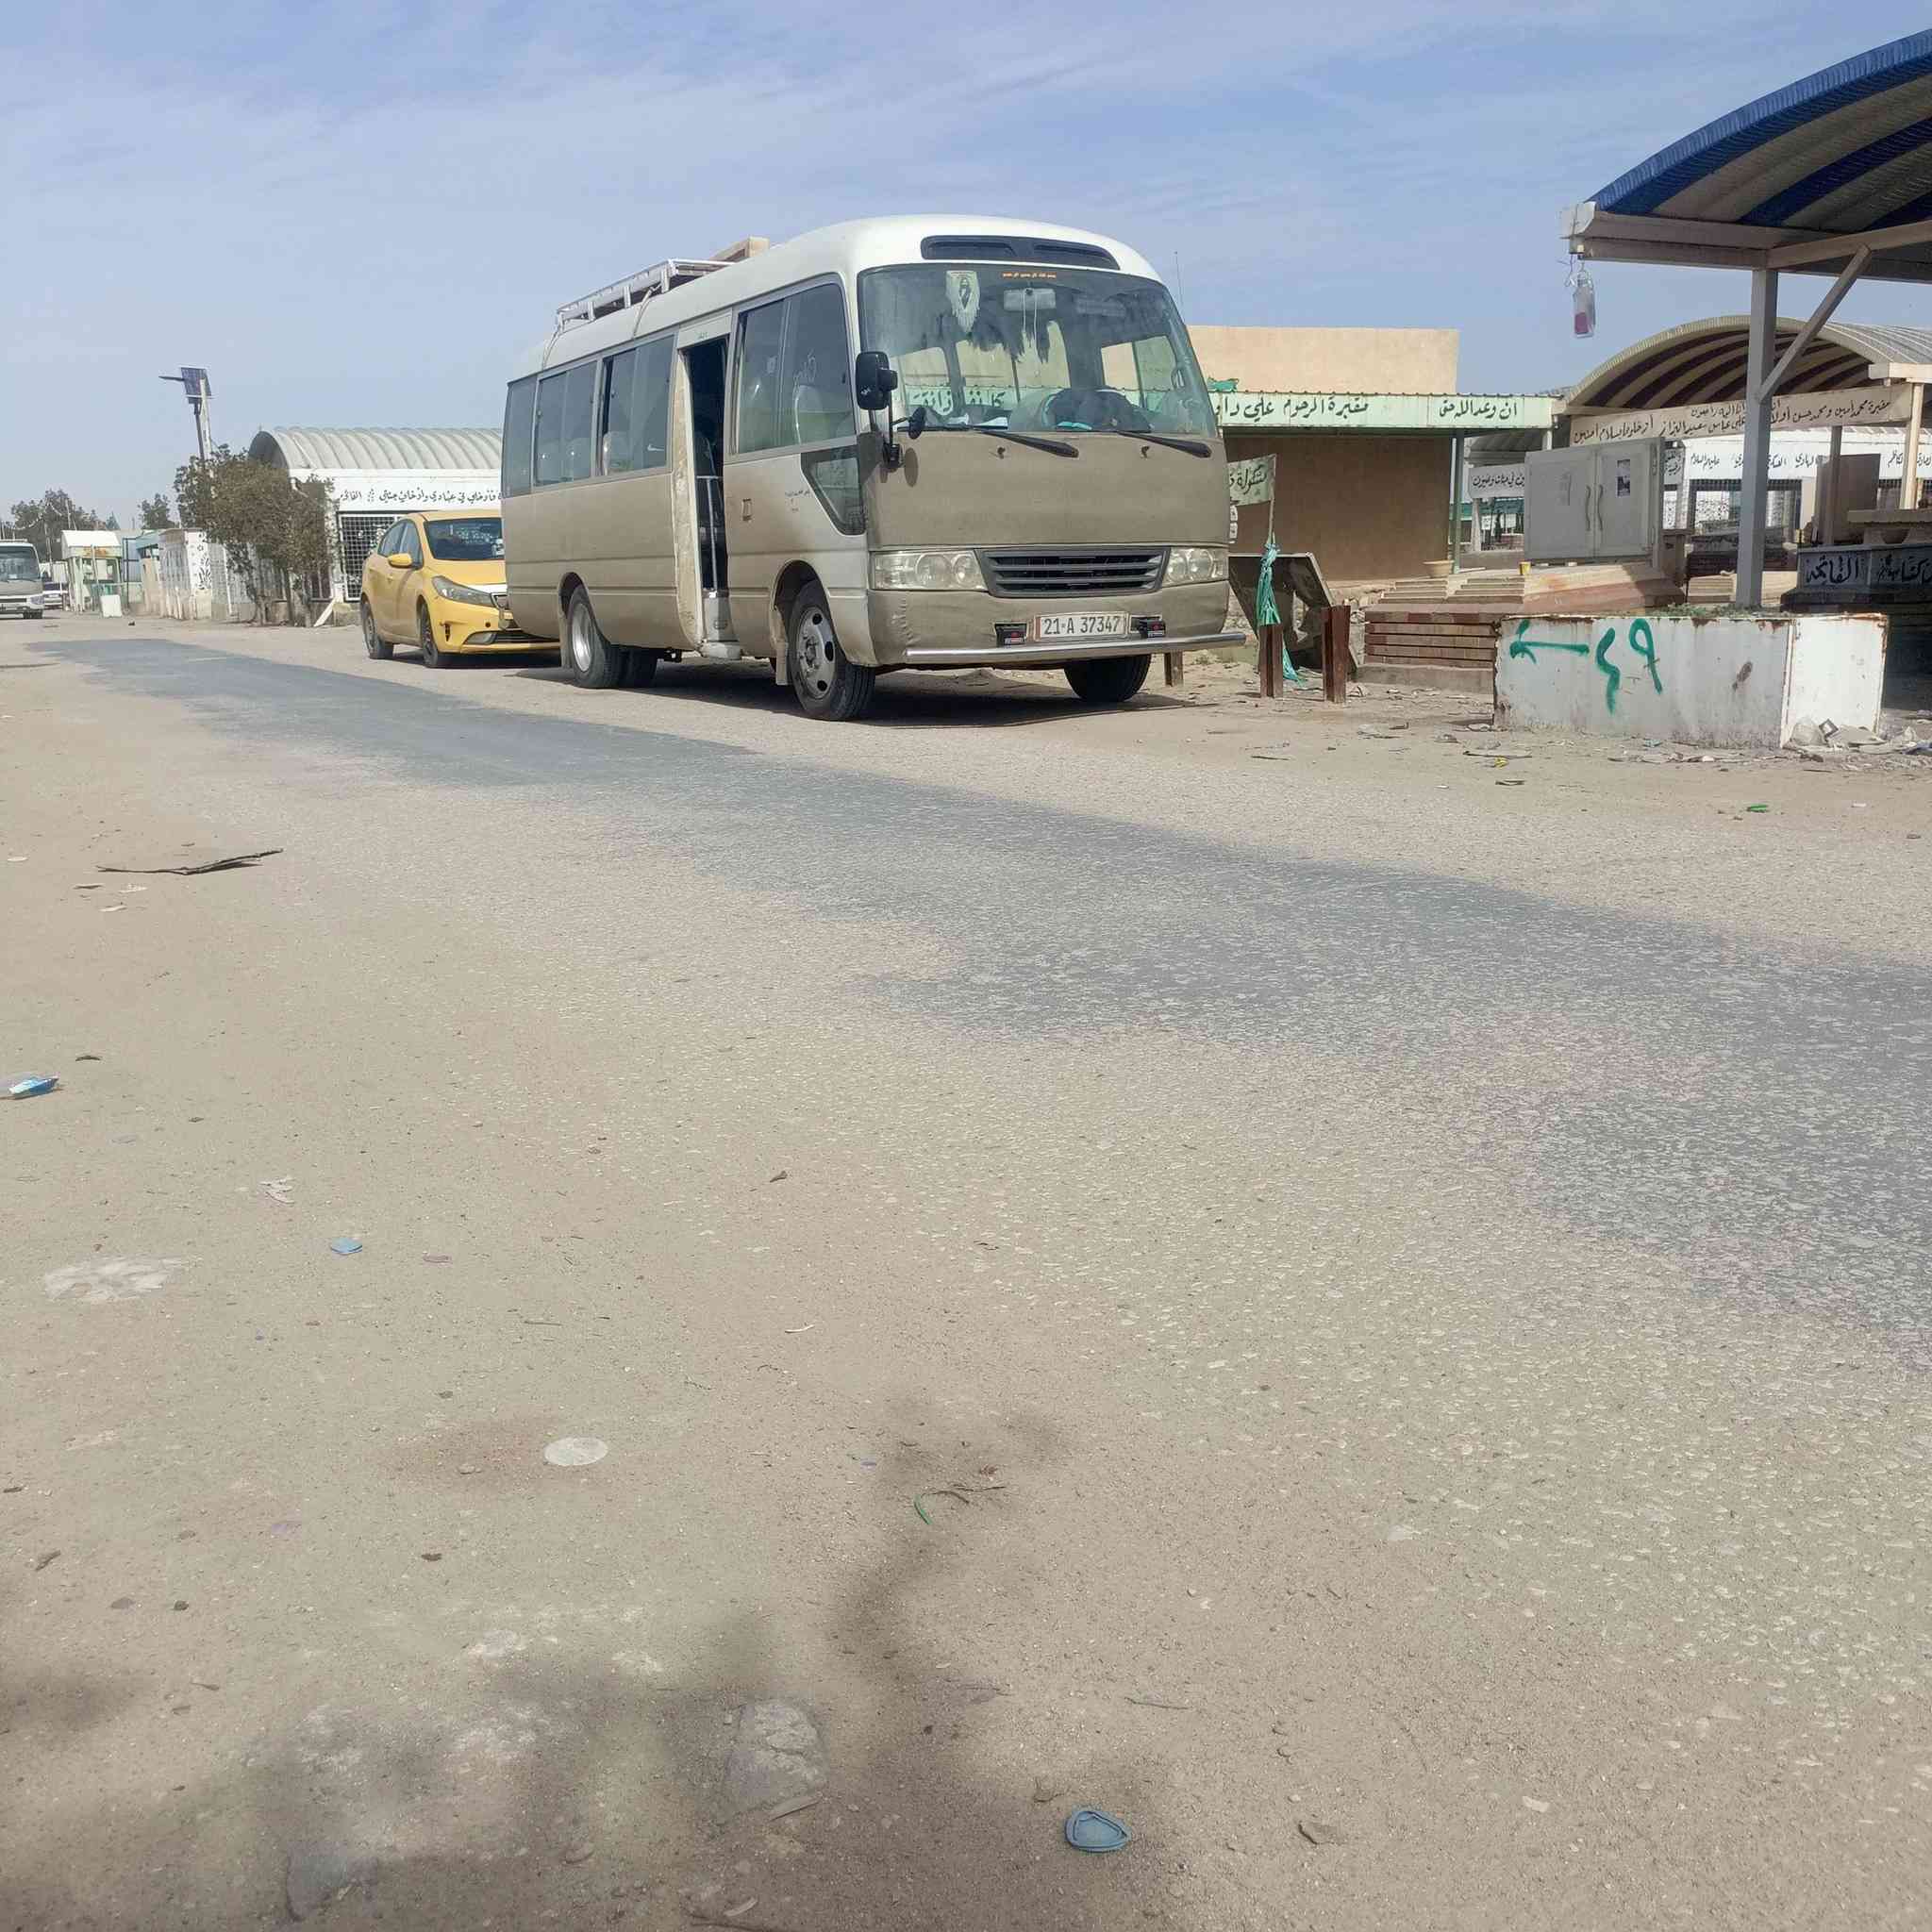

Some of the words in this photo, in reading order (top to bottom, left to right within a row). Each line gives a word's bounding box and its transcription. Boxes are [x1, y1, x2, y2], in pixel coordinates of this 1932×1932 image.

[1242, 397, 1274, 423] علي
[1327, 396, 1370, 420] مقبرة
[1454, 399, 1474, 419] الله
[1043, 618, 1061, 635] 21
[1066, 617, 1075, 634] A
[1079, 615, 1121, 634] 37347
